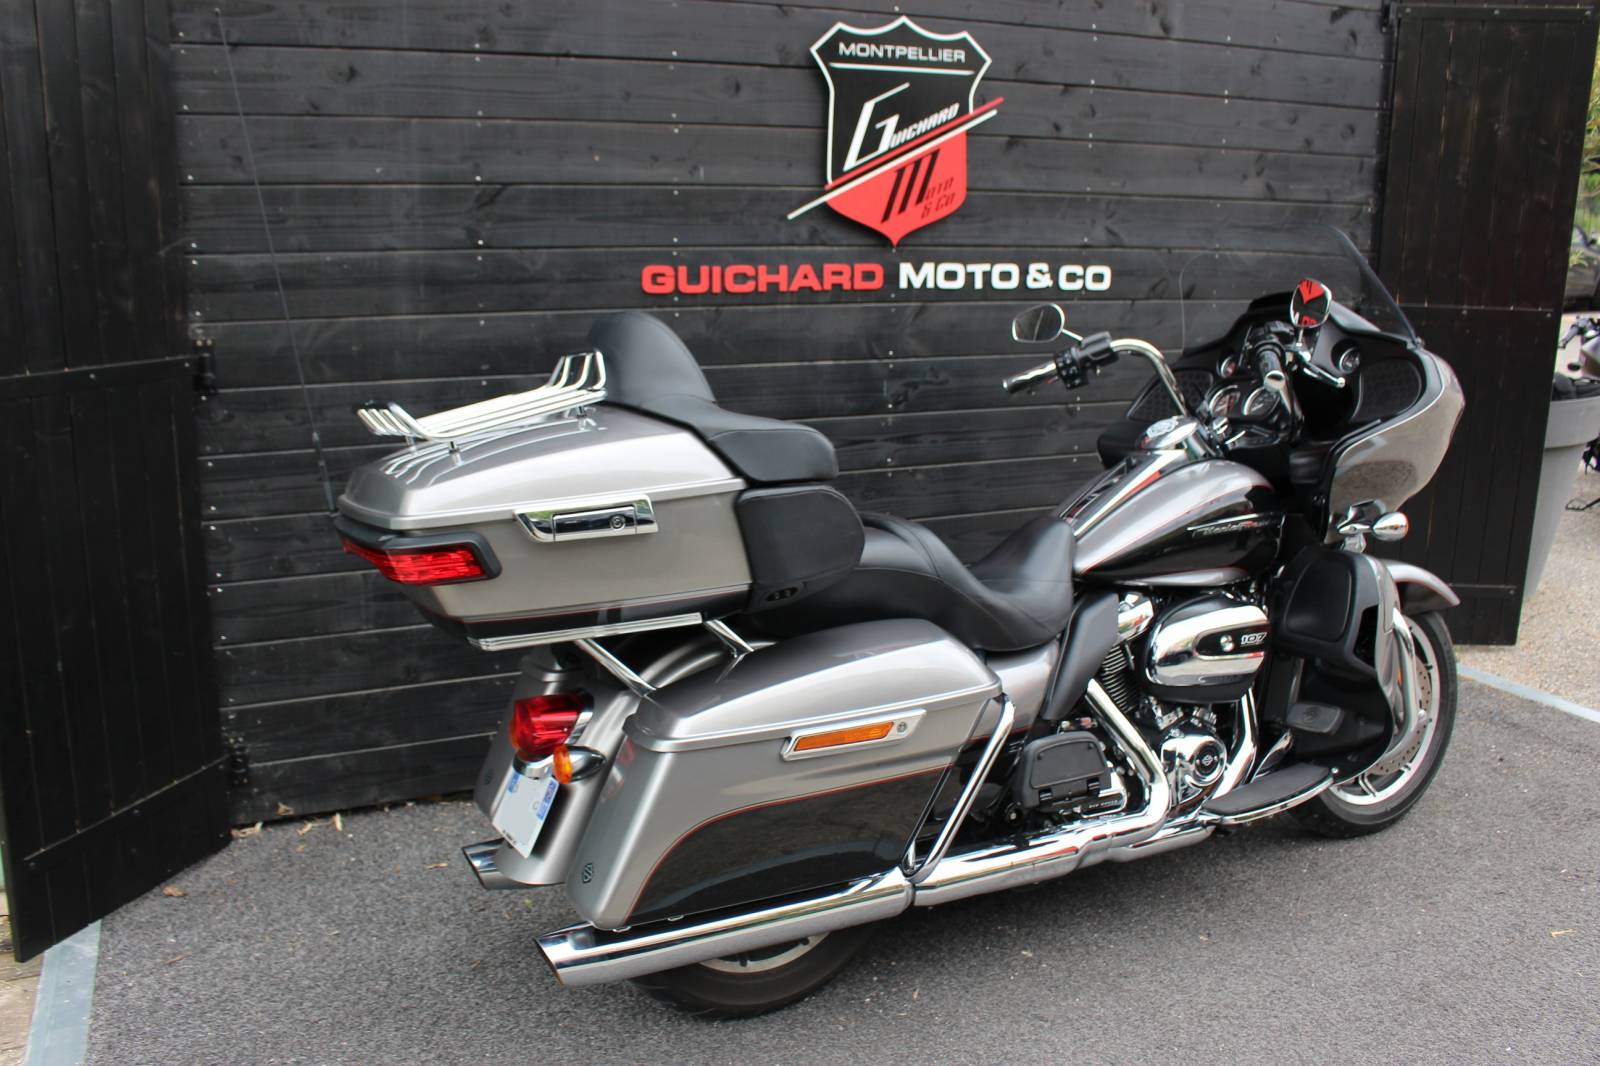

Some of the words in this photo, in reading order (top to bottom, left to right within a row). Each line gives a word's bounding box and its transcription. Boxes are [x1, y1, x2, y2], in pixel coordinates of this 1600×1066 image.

[838, 41, 966, 63] MONTPELLIER
[641, 263, 884, 294] GUICHARD
[1241, 632, 1267, 645] 107
